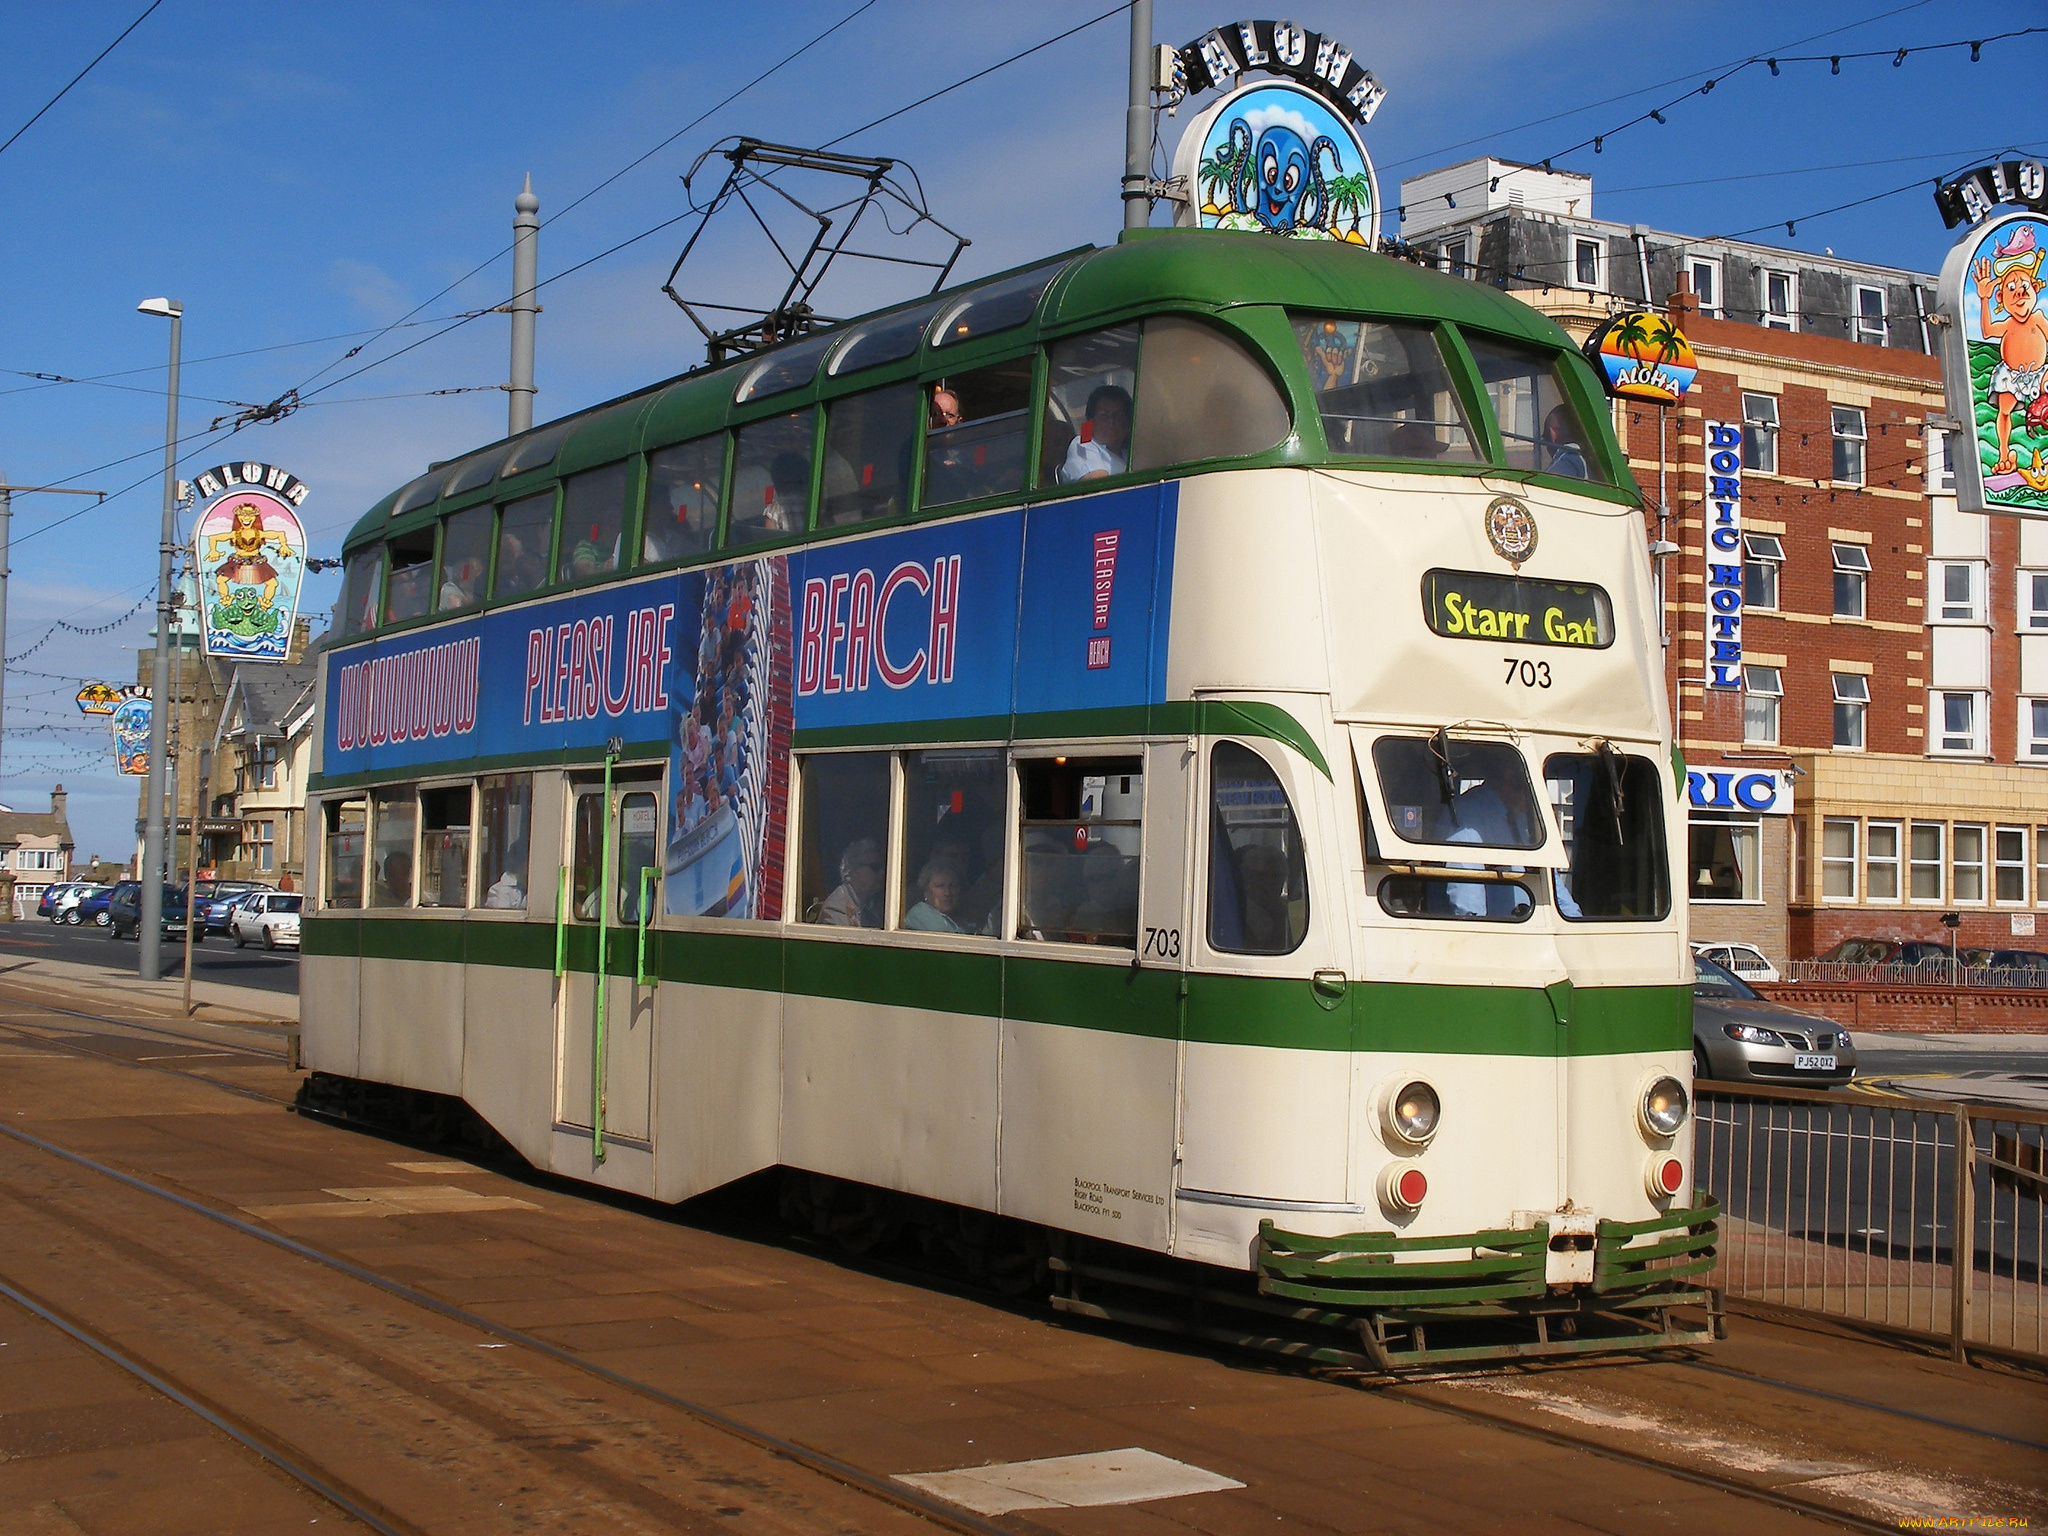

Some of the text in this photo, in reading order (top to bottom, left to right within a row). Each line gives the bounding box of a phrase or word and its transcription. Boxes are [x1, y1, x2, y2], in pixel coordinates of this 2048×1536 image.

[1199, 19, 1388, 124] ALOHA
[1616, 367, 1680, 397] ALOHA
[199, 461, 309, 506] ALOHA
[1708, 426, 1741, 690] DORIC HOTEL
[1095, 535, 1118, 624] PLEASURE
[1444, 592, 1530, 638] Starr
[523, 554, 962, 726] PLEASURE BEACH
[1088, 640, 1110, 665] BEACH
[1503, 658, 1552, 689] 703
[84, 703, 113, 712] ALOHA
[1143, 927, 1180, 958] 703
[1798, 1056, 1819, 1067] PJ52
